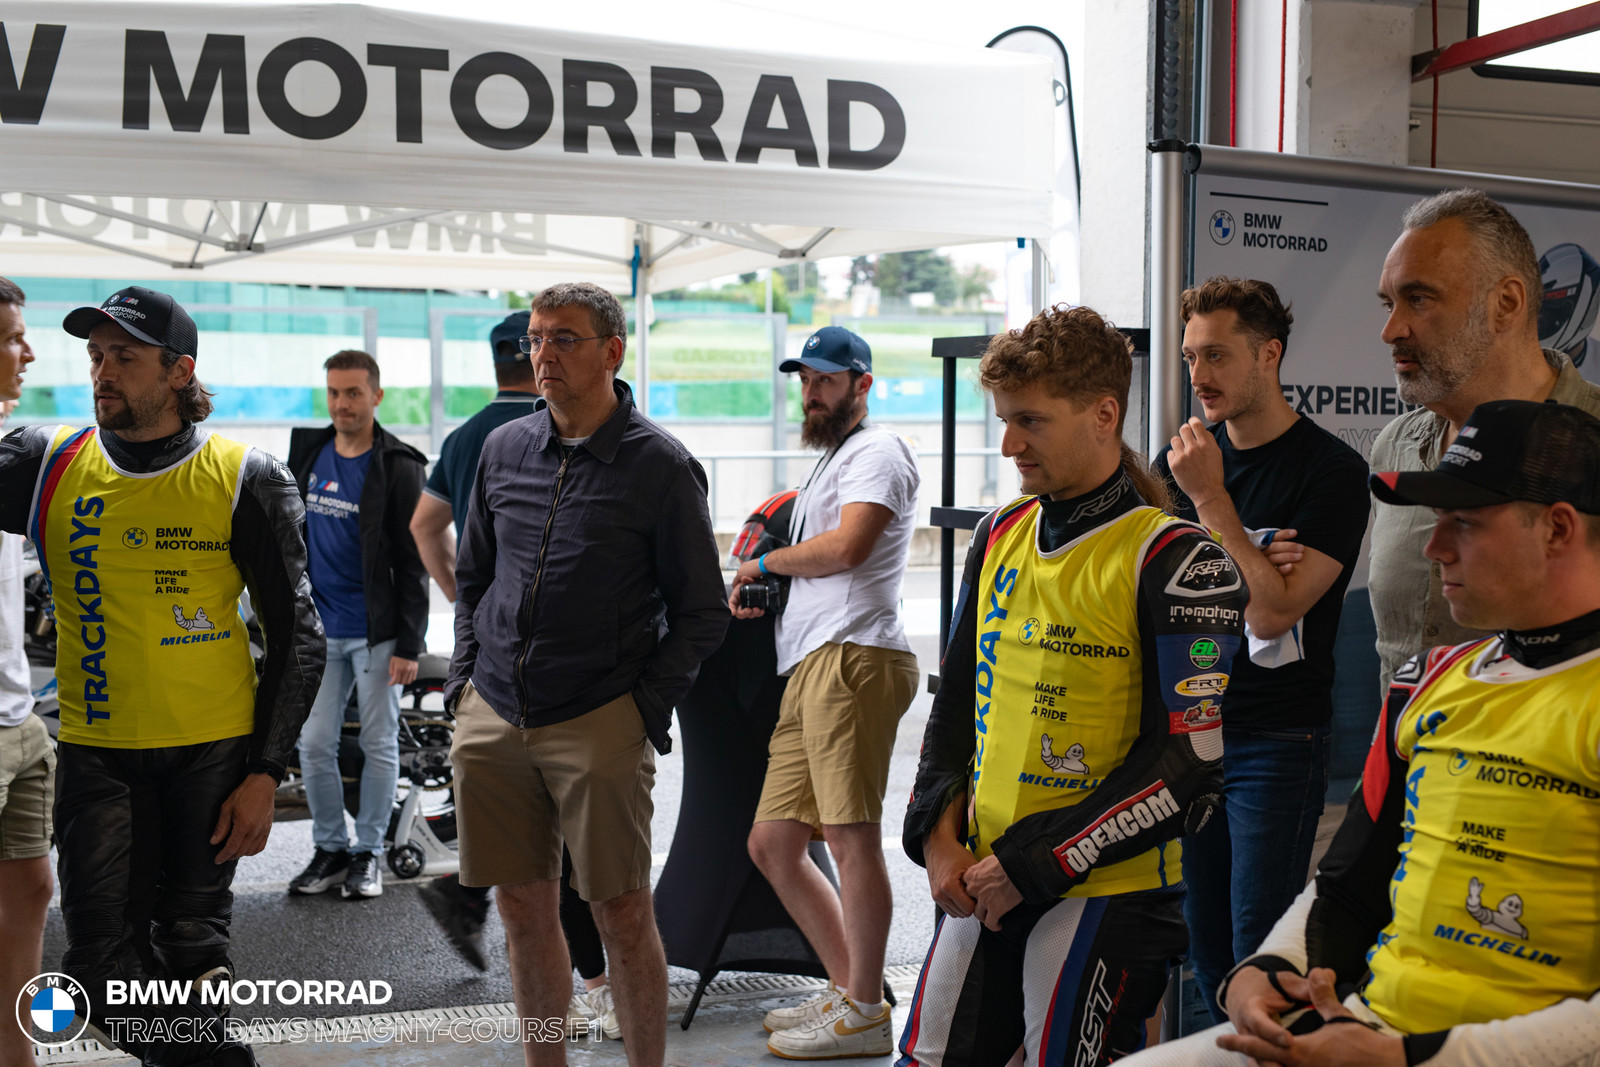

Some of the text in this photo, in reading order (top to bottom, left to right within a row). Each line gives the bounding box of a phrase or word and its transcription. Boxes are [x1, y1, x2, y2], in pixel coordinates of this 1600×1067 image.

[122, 29, 907, 171] MOTORRAD
[1244, 213, 1282, 229] BMW
[1243, 232, 1328, 252] MOTORRAD
[318, 496, 359, 513] MOTORRA
[156, 528, 192, 537] BMW
[155, 540, 229, 551] MOTORRAD
[1183, 559, 1232, 582] RST
[155, 577, 177, 585] LIFE
[69, 496, 110, 725] TRACKDAYS
[160, 630, 231, 646] MICHELIN
[1040, 638, 1130, 658] MOTORRAD
[1035, 682, 1067, 697] MAKE
[1034, 693, 1055, 707] LIFE
[1031, 706, 1067, 722] A RIDE
[1018, 772, 1104, 789] MICHELI
[1462, 821, 1506, 841] MAKE
[1470, 845, 1507, 863] RIDE
[1433, 924, 1562, 967] MICHELIN
